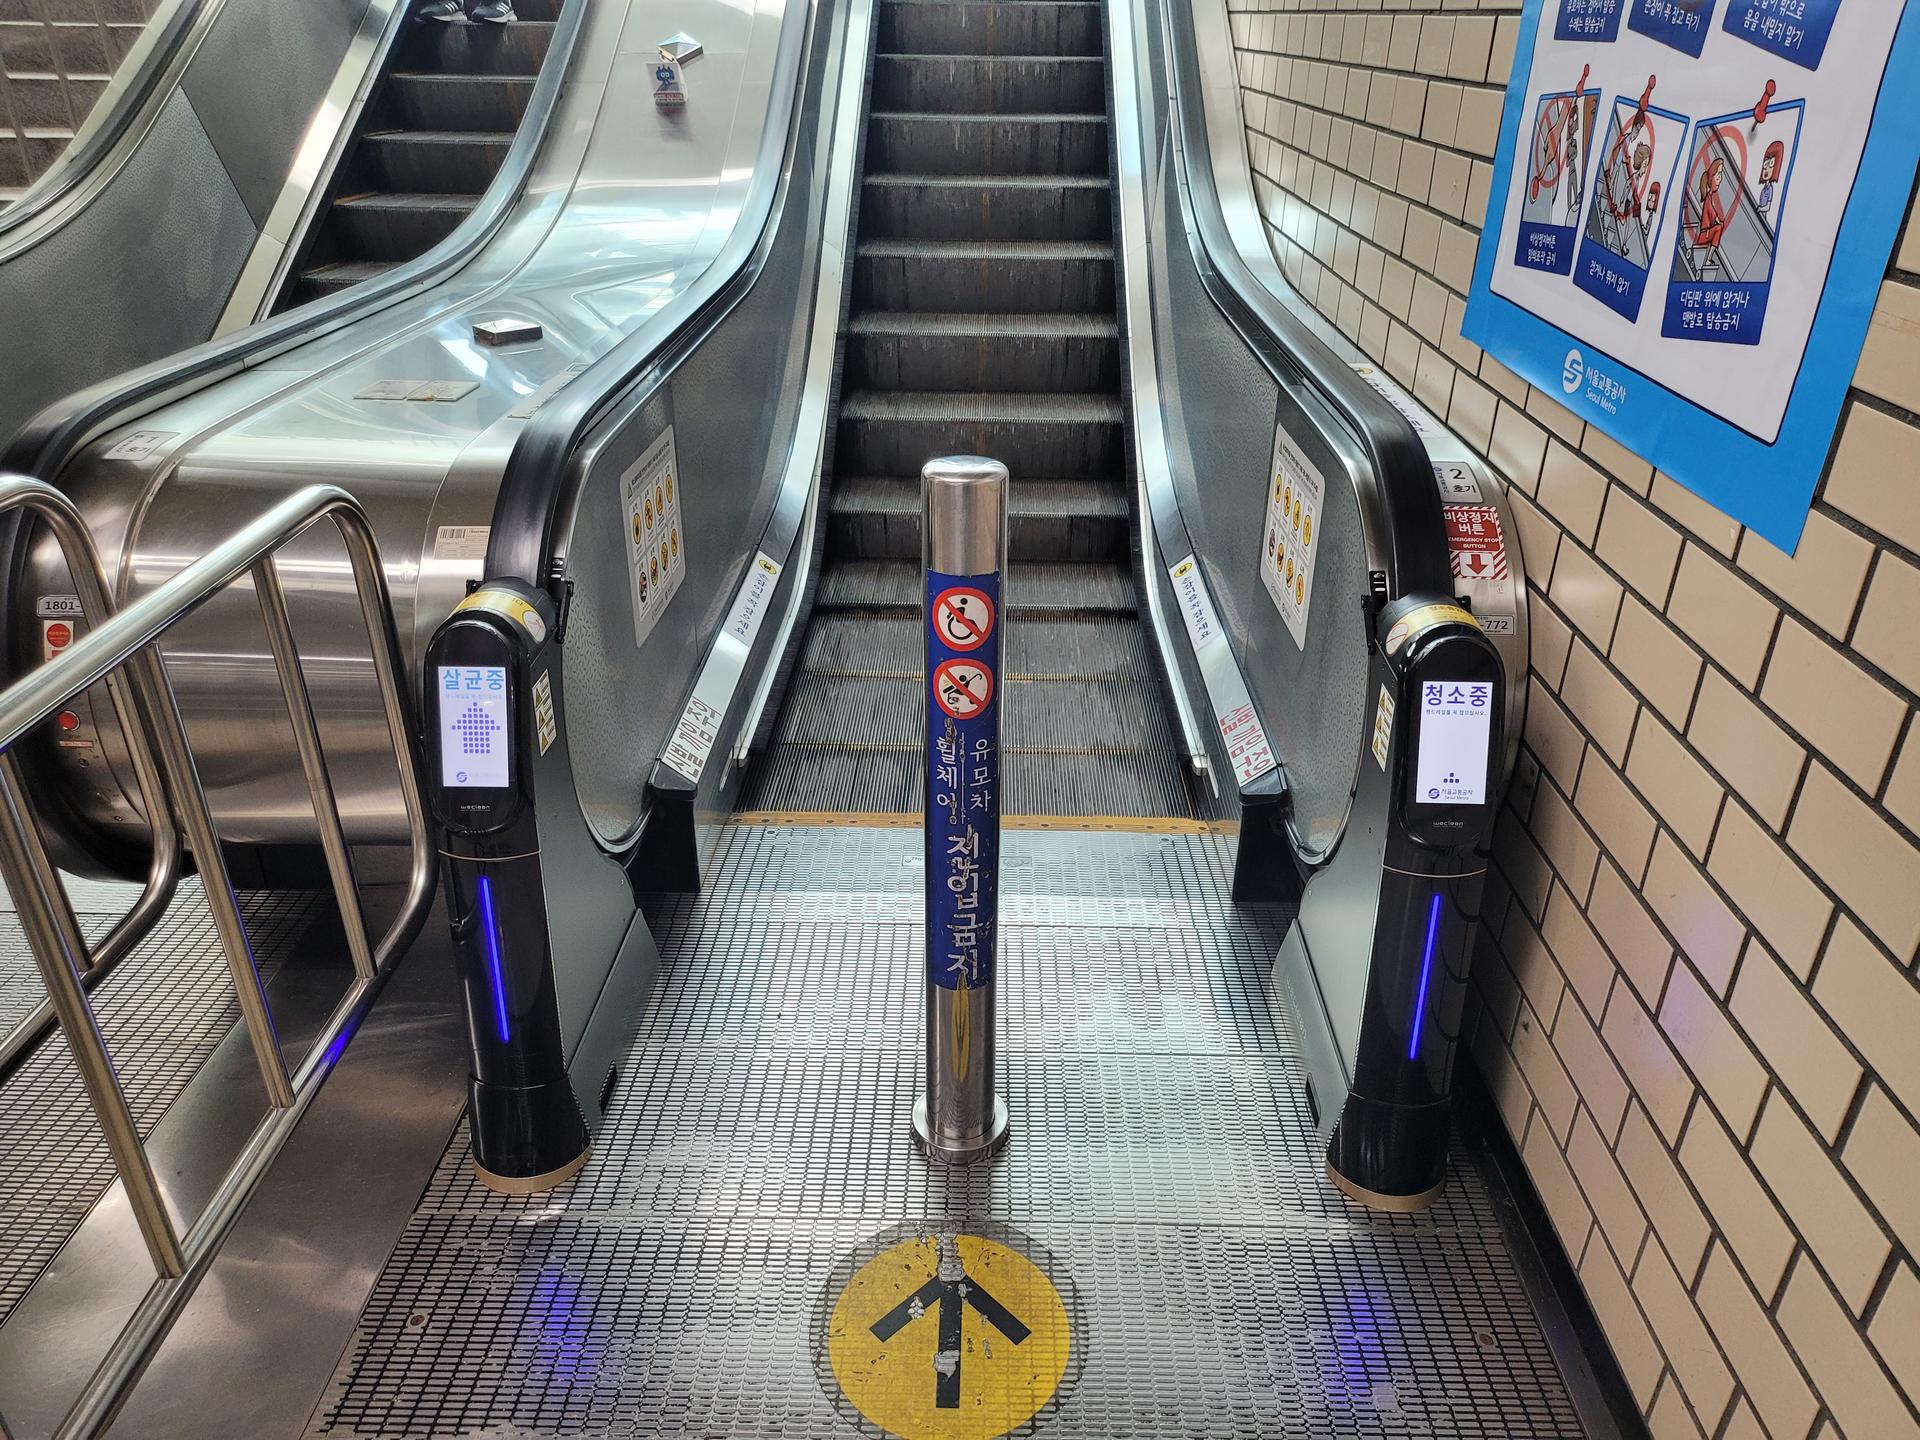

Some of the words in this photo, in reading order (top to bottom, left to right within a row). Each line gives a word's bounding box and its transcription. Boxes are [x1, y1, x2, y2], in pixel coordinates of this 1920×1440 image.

[1603, 0, 1616, 14] 탑승
[1568, 16, 1584, 32] 수레는
[1584, 16, 1606, 33] 탑승금지
[1685, 11, 1701, 32] 타기
[1743, 9, 1760, 31] 몸을
[1760, 16, 1786, 42] 내밀지
[1784, 25, 1804, 50] 말기
[1605, 269, 1618, 289] 뛰지
[1616, 276, 1630, 297] 않기
[1680, 289, 1703, 308] 디딤판
[1703, 290, 1721, 308] 위에
[1722, 290, 1750, 309] 앉거나
[1682, 311, 1704, 328] 맨발로
[1706, 312, 1740, 330] 탑승금지
[1585, 366, 1626, 404] 서울교통공사
[1585, 387, 1601, 404] Seoul
[1599, 396, 1617, 415] Metro
[1449, 468, 1466, 480] 2
[1453, 484, 1477, 494] 호기
[1444, 511, 1496, 523] 비상정지
[1459, 523, 1485, 535] 버튼
[443, 669, 504, 690] 살균중
[1425, 684, 1488, 707] 청소중
[686, 695, 722, 729] 주의
[970, 739, 991, 812] 유모차
[1235, 746, 1274, 784] 주의
